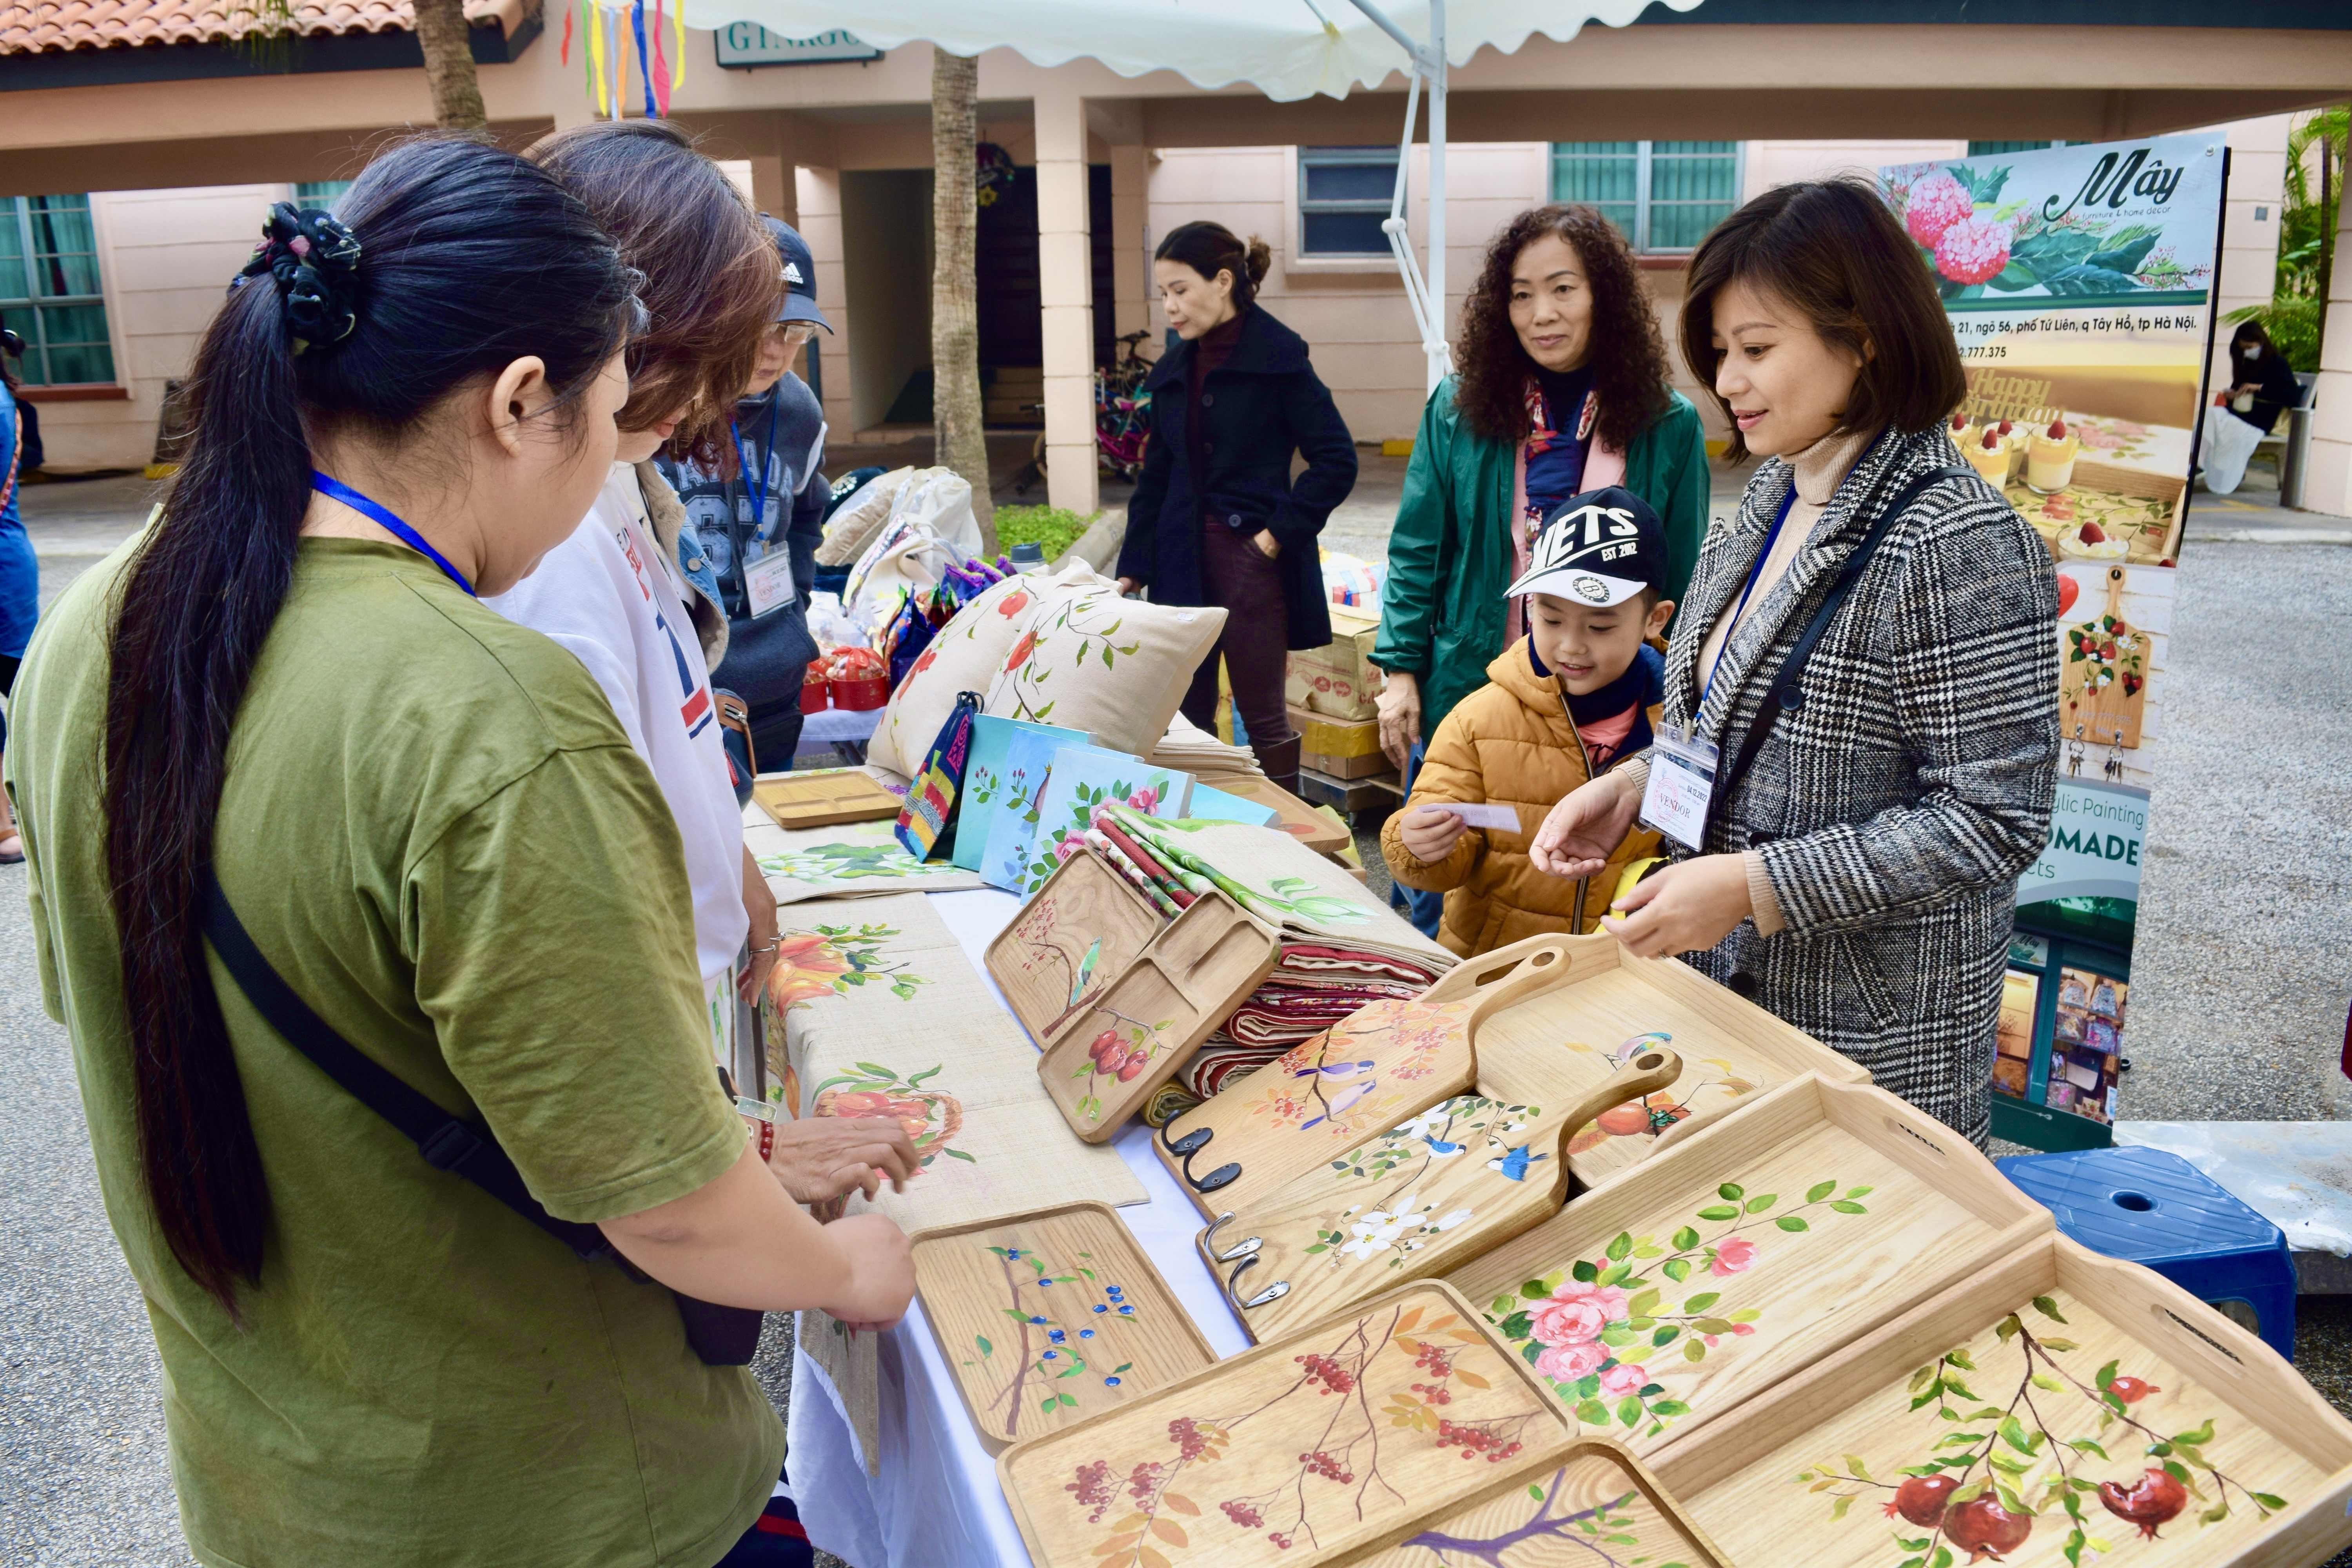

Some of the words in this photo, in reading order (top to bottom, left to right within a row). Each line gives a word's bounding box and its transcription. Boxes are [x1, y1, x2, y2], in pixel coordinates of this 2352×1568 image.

[728, 20, 859, 51] GIGO
[2043, 148, 2185, 222] Mây
[1959, 322, 1972, 334] 21,
[1976, 321, 1994, 335] ngõ
[1998, 321, 2013, 334] 56,
[2016, 318, 2038, 334] phố
[2040, 319, 2053, 331] Tứ
[2055, 319, 2078, 332] Liên,
[2082, 321, 2089, 332] q
[2093, 317, 2112, 332] Tây
[2139, 317, 2150, 332] tp
[2154, 316, 2171, 329] Hà
[2175, 316, 2197, 332] Nội.
[1971, 368, 2051, 406] Happy
[1531, 505, 1638, 568] NETS
[1601, 547, 1617, 562] EST
[1659, 793, 1690, 818] VENDOR
[2083, 798, 2144, 831] Painting
